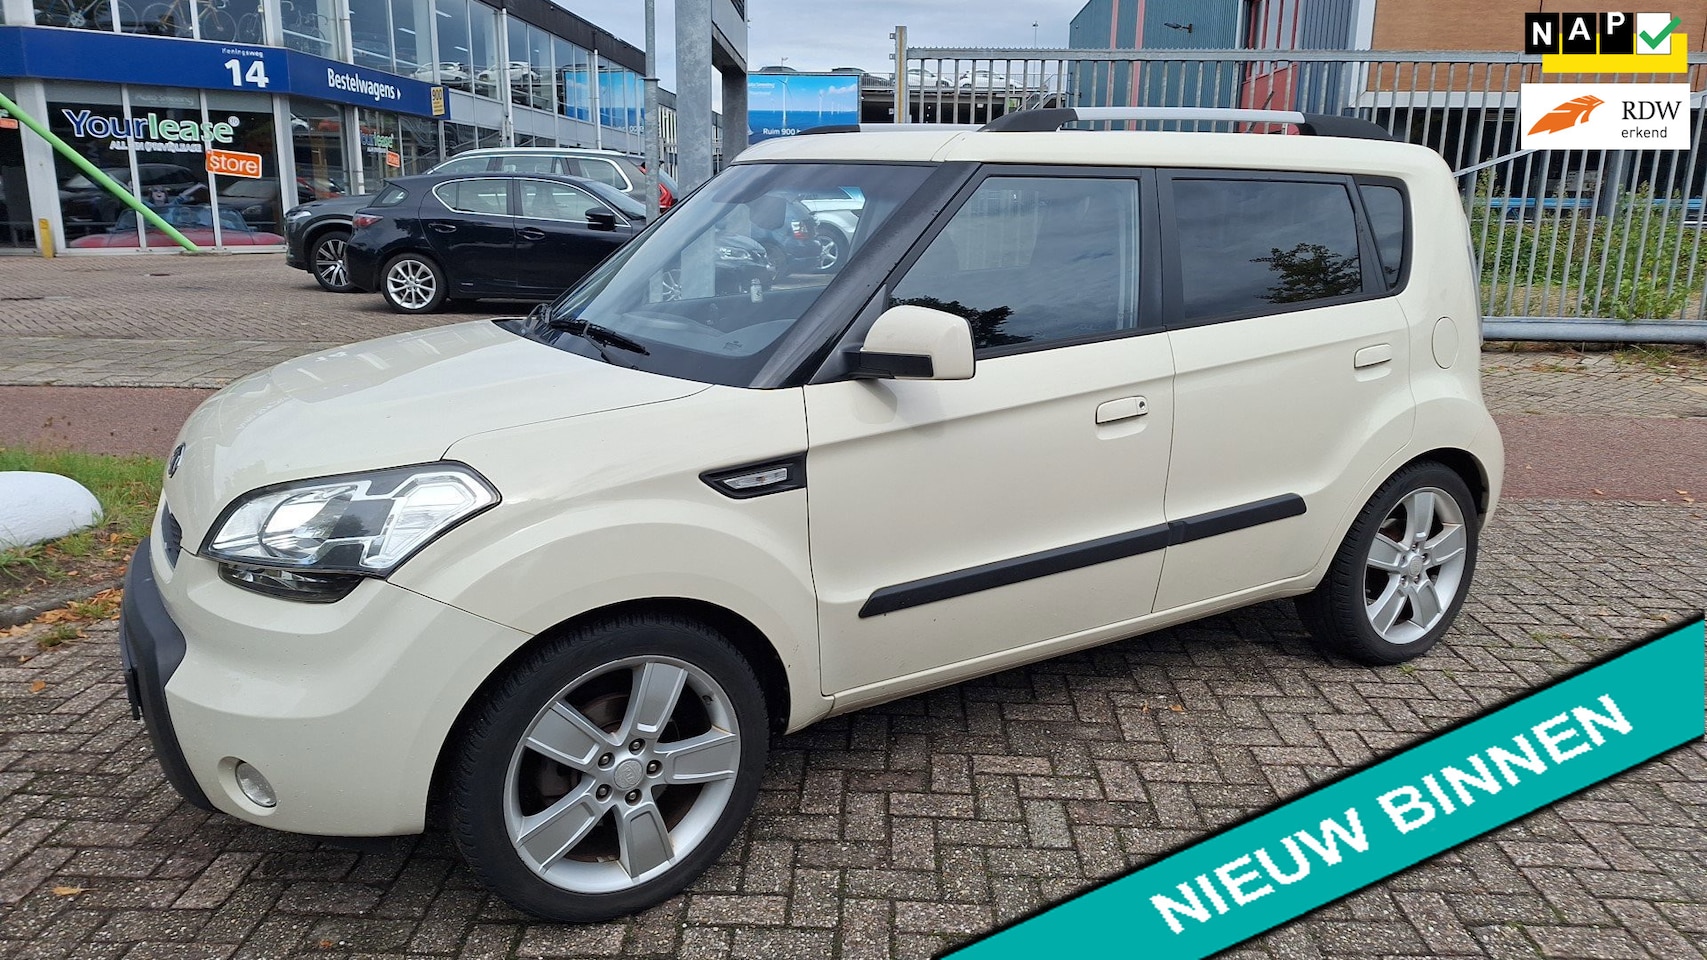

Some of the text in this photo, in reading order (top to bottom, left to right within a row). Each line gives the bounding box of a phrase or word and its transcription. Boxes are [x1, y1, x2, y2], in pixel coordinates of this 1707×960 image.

[224, 58, 270, 88] 14
[327, 67, 395, 101] Bestelwagens
[762, 127, 796, 136] Ruim 900
[209, 153, 258, 175] store
